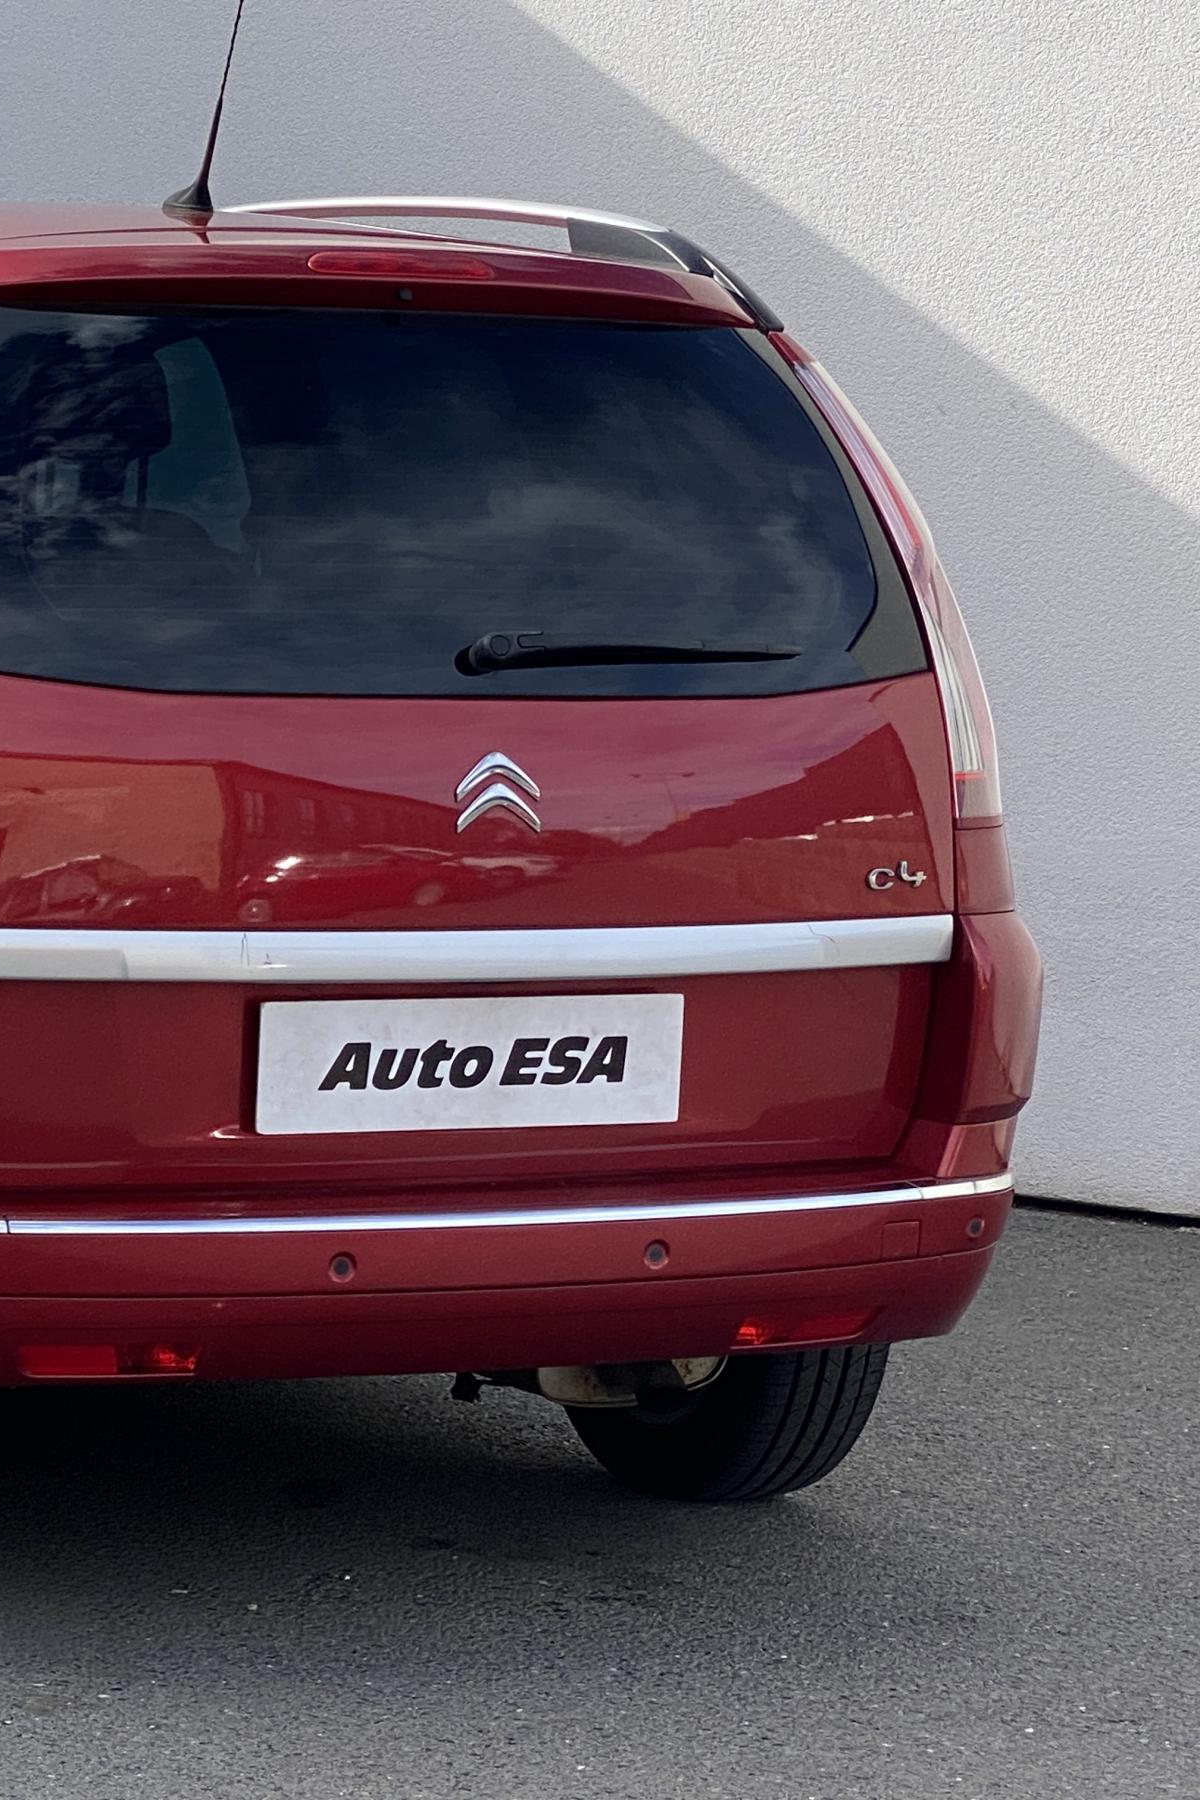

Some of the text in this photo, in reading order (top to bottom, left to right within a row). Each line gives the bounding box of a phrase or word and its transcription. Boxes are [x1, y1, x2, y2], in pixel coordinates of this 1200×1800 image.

[867, 860, 927, 890] C4
[318, 1036, 629, 1091] Auto ESA
